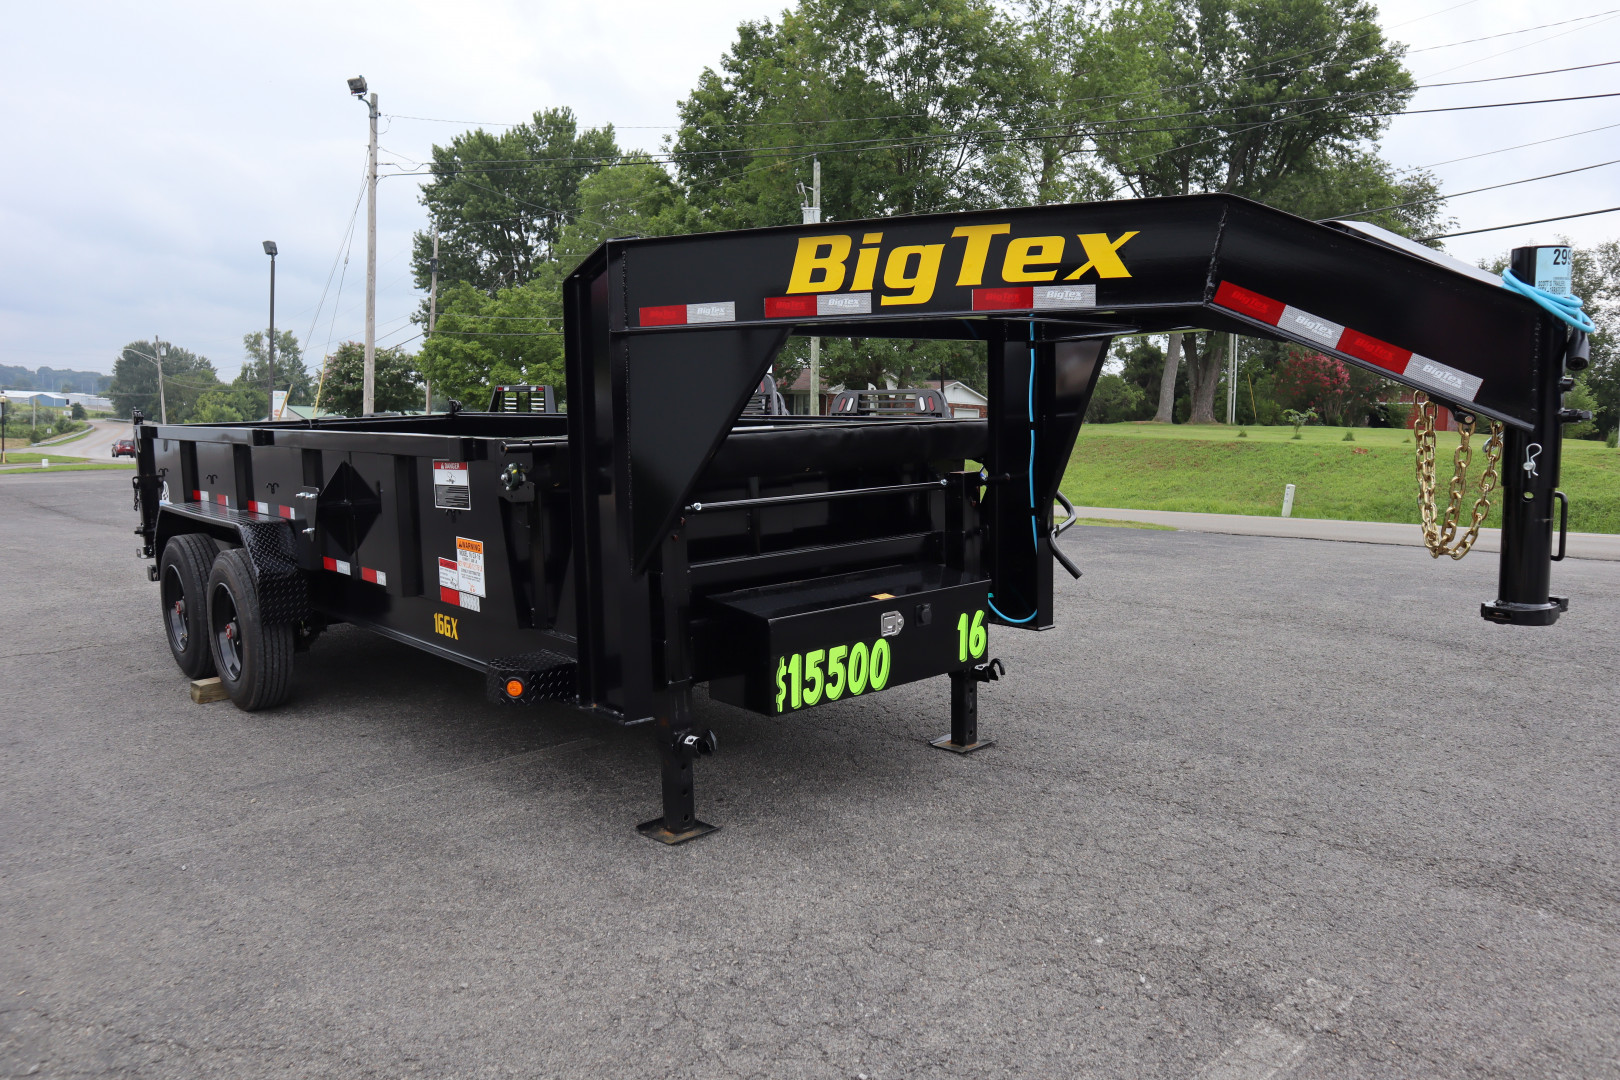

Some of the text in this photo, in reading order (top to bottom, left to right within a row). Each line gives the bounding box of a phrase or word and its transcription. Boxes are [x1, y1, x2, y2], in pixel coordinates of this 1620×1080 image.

[786, 223, 1140, 306] BigTex
[827, 298, 860, 307] BigTex
[1046, 290, 1083, 300] BigTex
[1295, 315, 1334, 336] BigTex
[1422, 364, 1464, 387] BigTex
[445, 462, 460, 470] DANGER
[434, 612, 459, 640] 16GX
[957, 609, 987, 663] 16
[776, 638, 891, 713] $15500
